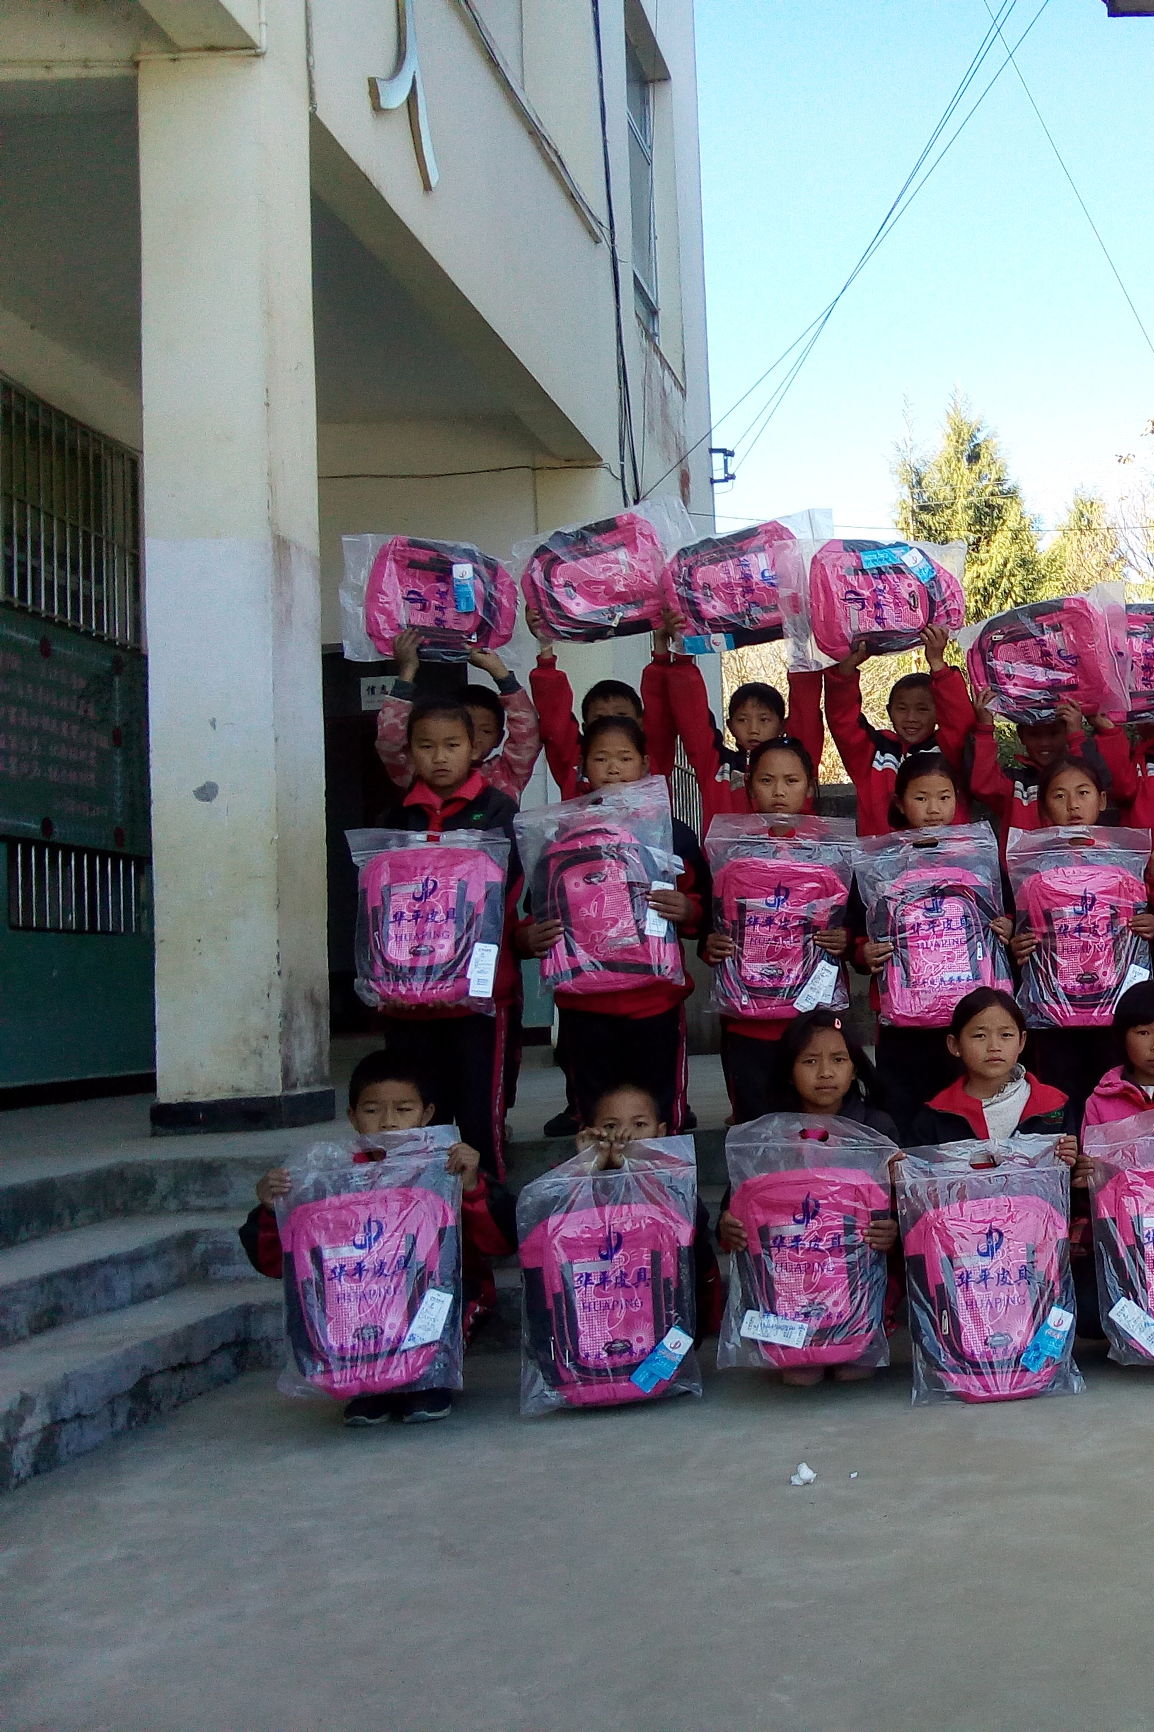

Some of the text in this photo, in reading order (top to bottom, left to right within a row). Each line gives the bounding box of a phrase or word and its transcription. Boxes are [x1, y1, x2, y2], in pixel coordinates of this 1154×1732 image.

[574, 1269, 652, 1291] 华平皮具
[955, 1264, 1034, 1290] 华平皮具
